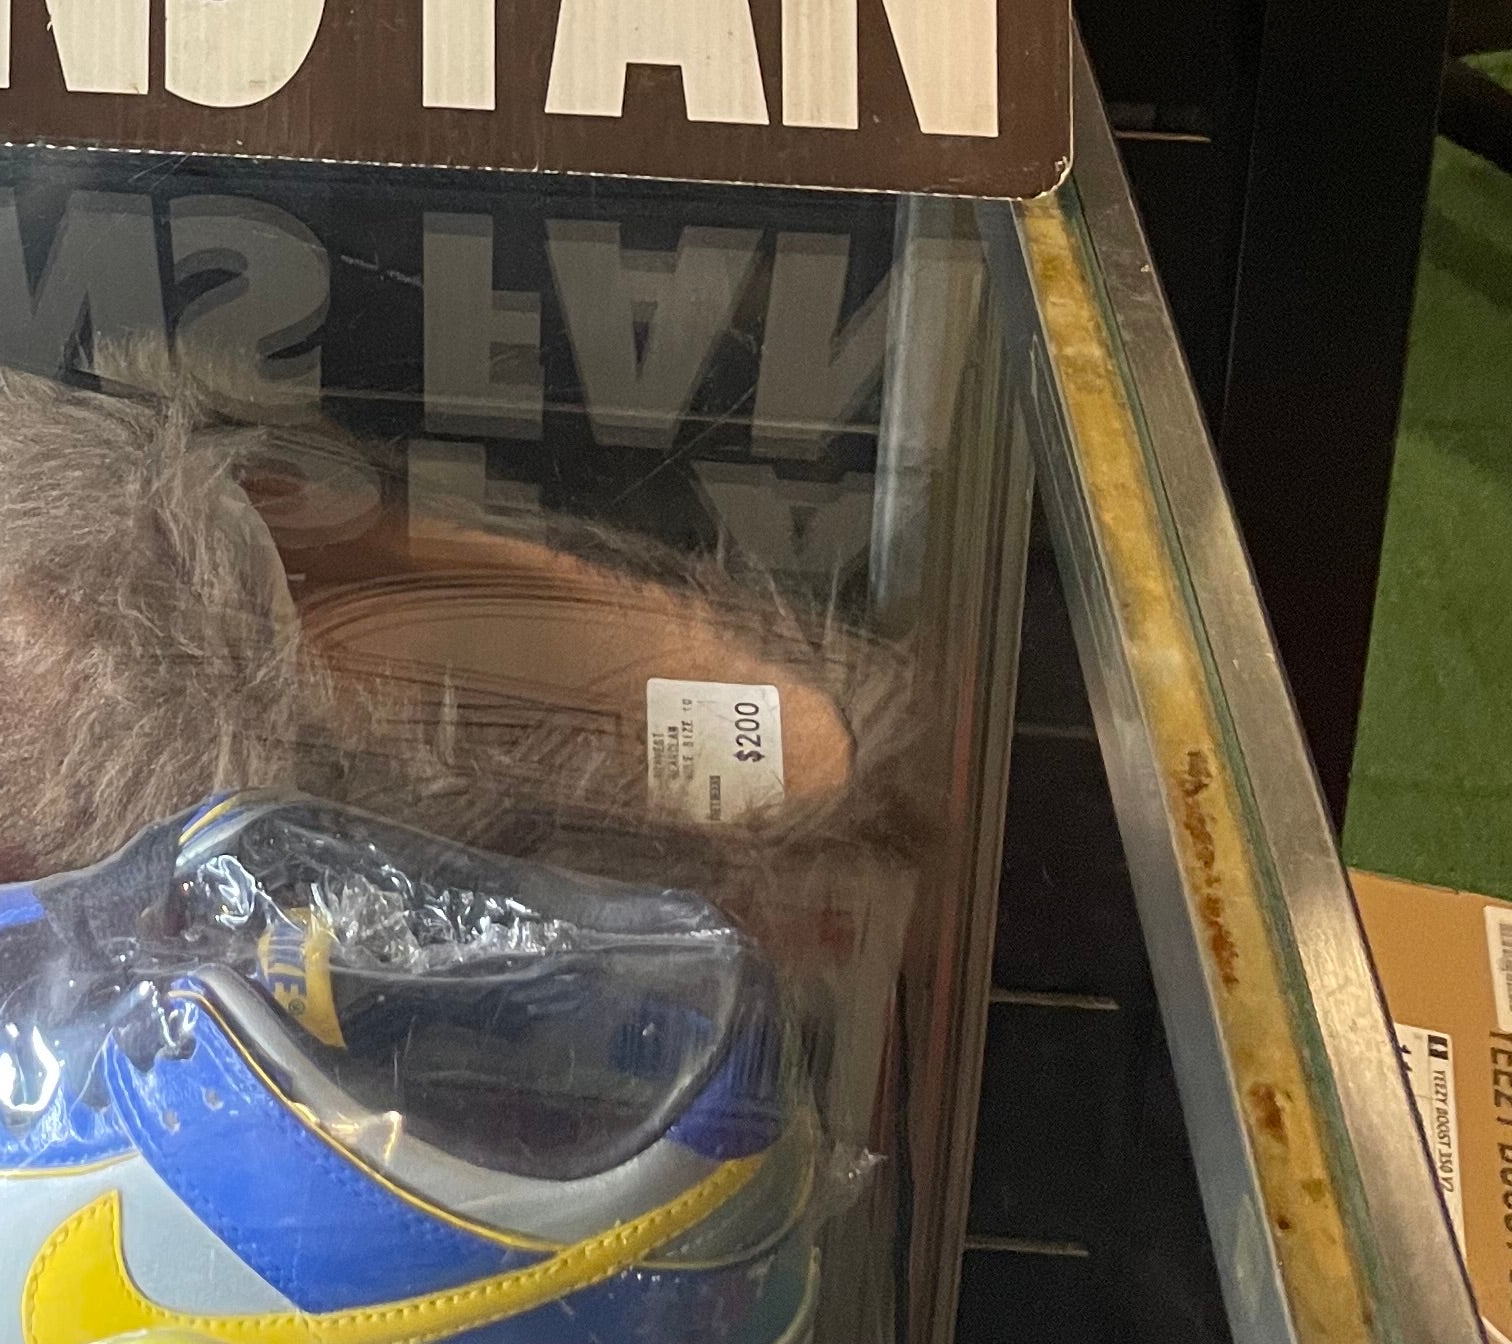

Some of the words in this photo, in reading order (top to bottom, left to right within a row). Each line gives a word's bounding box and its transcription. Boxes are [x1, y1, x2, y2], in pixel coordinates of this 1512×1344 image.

[733, 702, 766, 763] $200
[1432, 1069, 1449, 1107] YEEZY
[1435, 1106, 1452, 1149] BOOST
